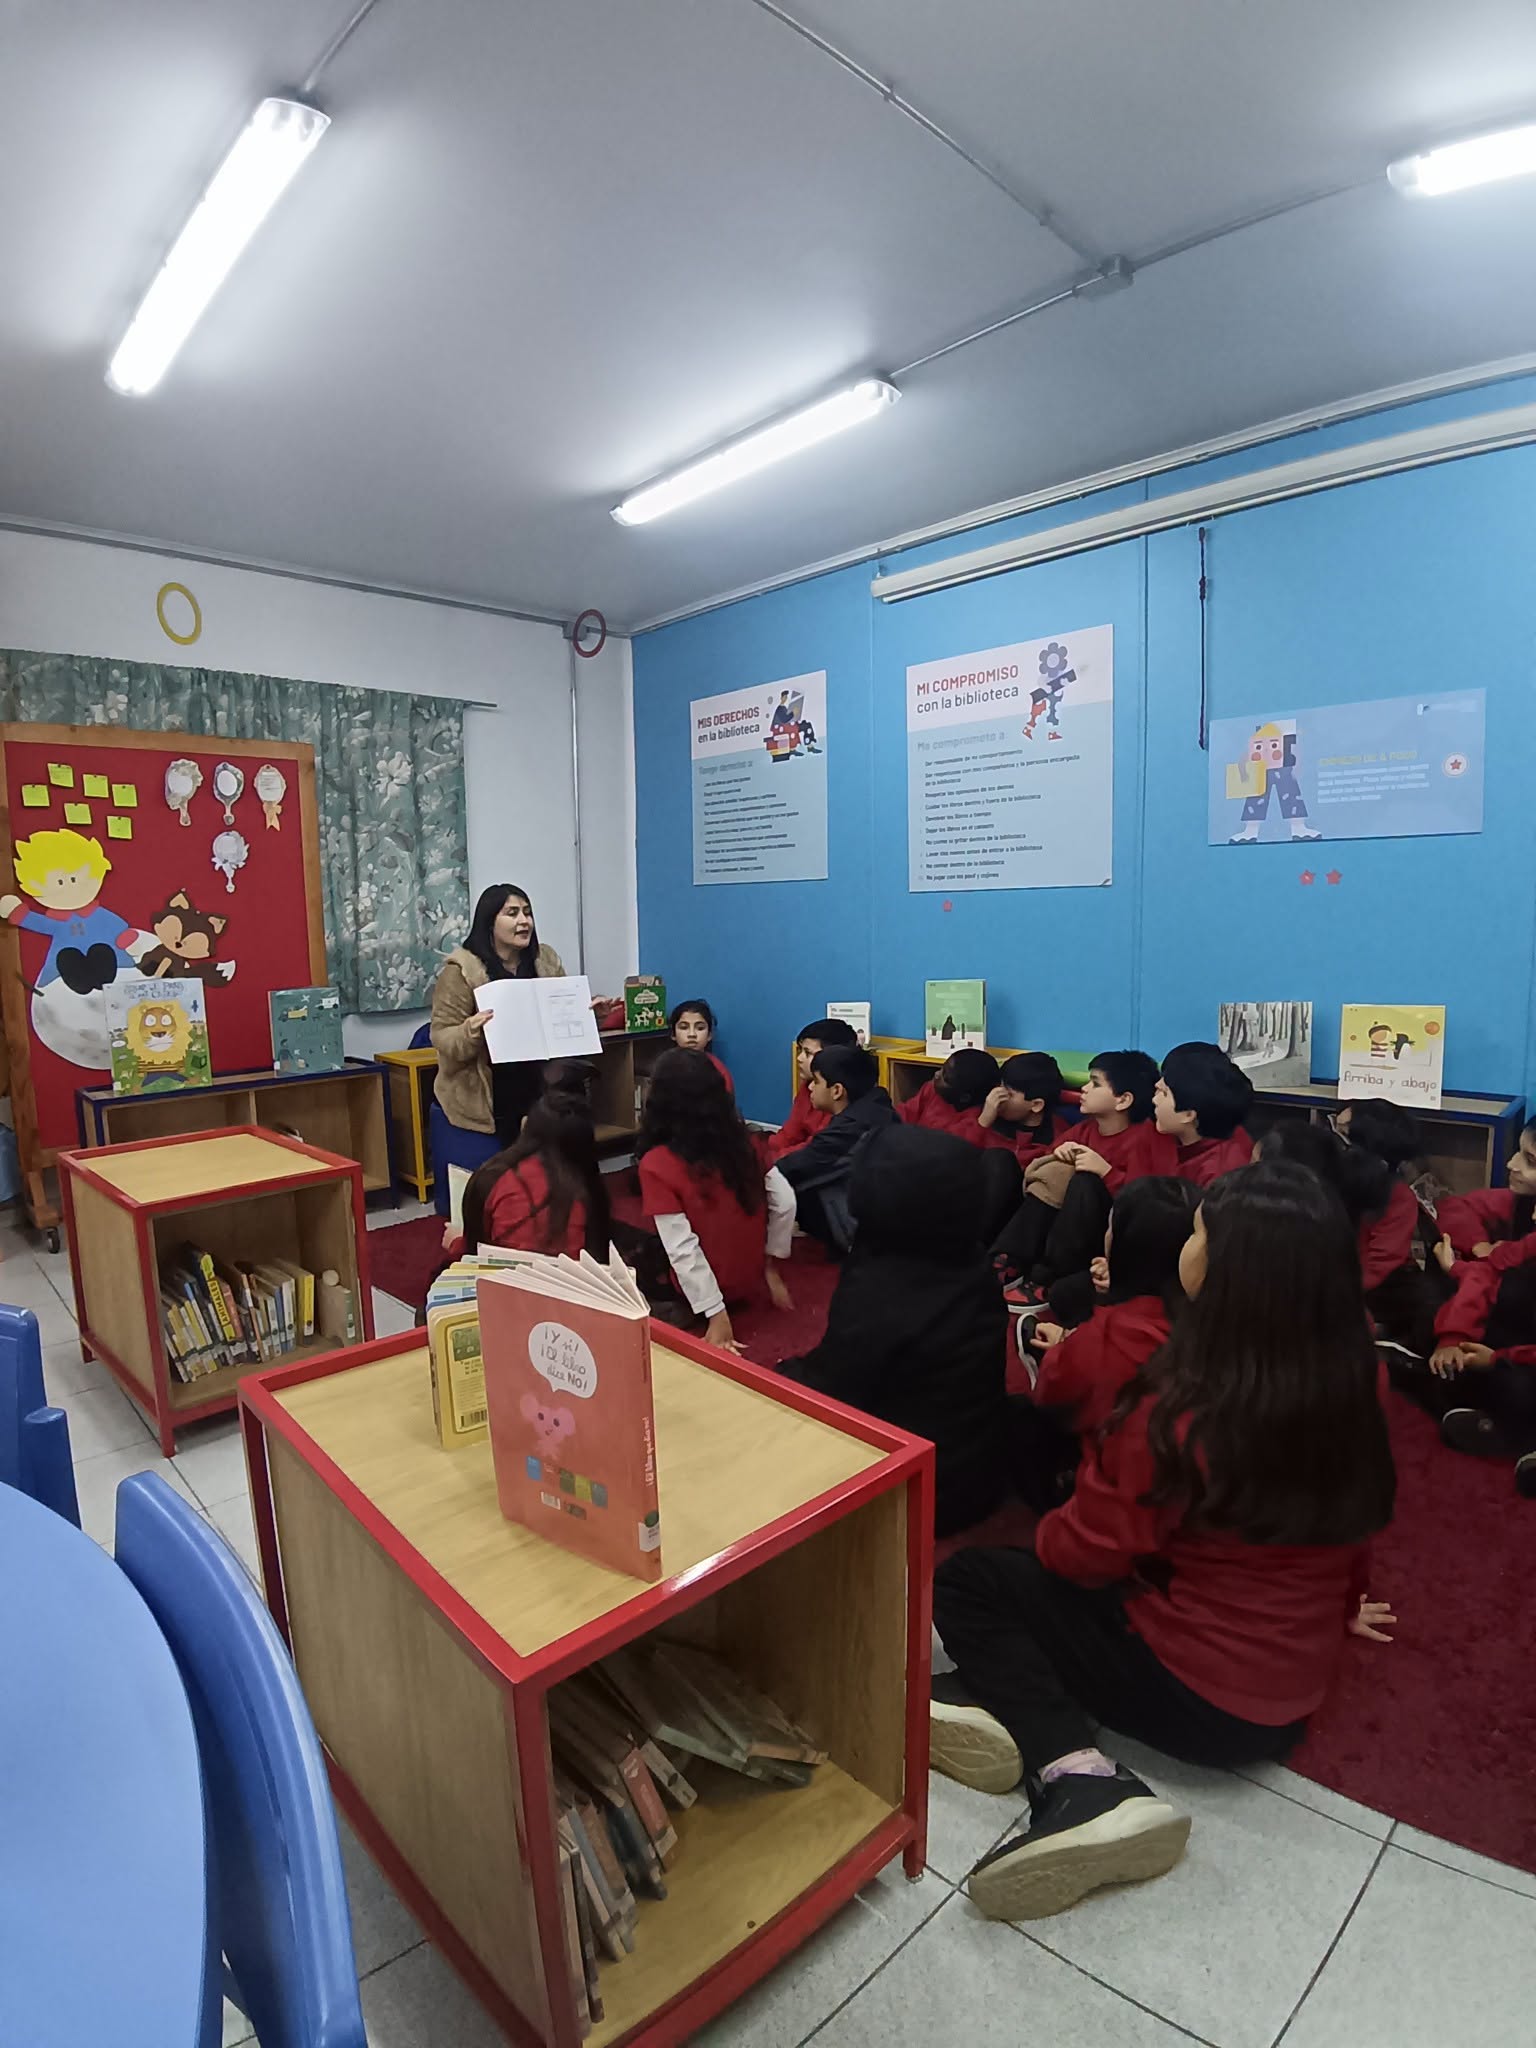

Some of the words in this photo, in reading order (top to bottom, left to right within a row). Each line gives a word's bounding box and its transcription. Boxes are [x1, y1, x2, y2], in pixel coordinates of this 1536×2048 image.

[917, 682, 929, 696] MI
[932, 665, 1018, 693] COMPROMISO
[917, 701, 938, 713] con
[942, 697, 952, 709] la
[955, 686, 1018, 707] biblioteca
[698, 716, 712, 729] MIS
[714, 706, 760, 726] DERECHOS
[698, 734, 708, 743] en
[710, 730, 716, 741] la
[718, 724, 760, 740] biblioteca
[1344, 1070, 1384, 1085] Arriba
[1388, 1078, 1396, 1088] y
[1402, 1076, 1438, 1092] abajo
